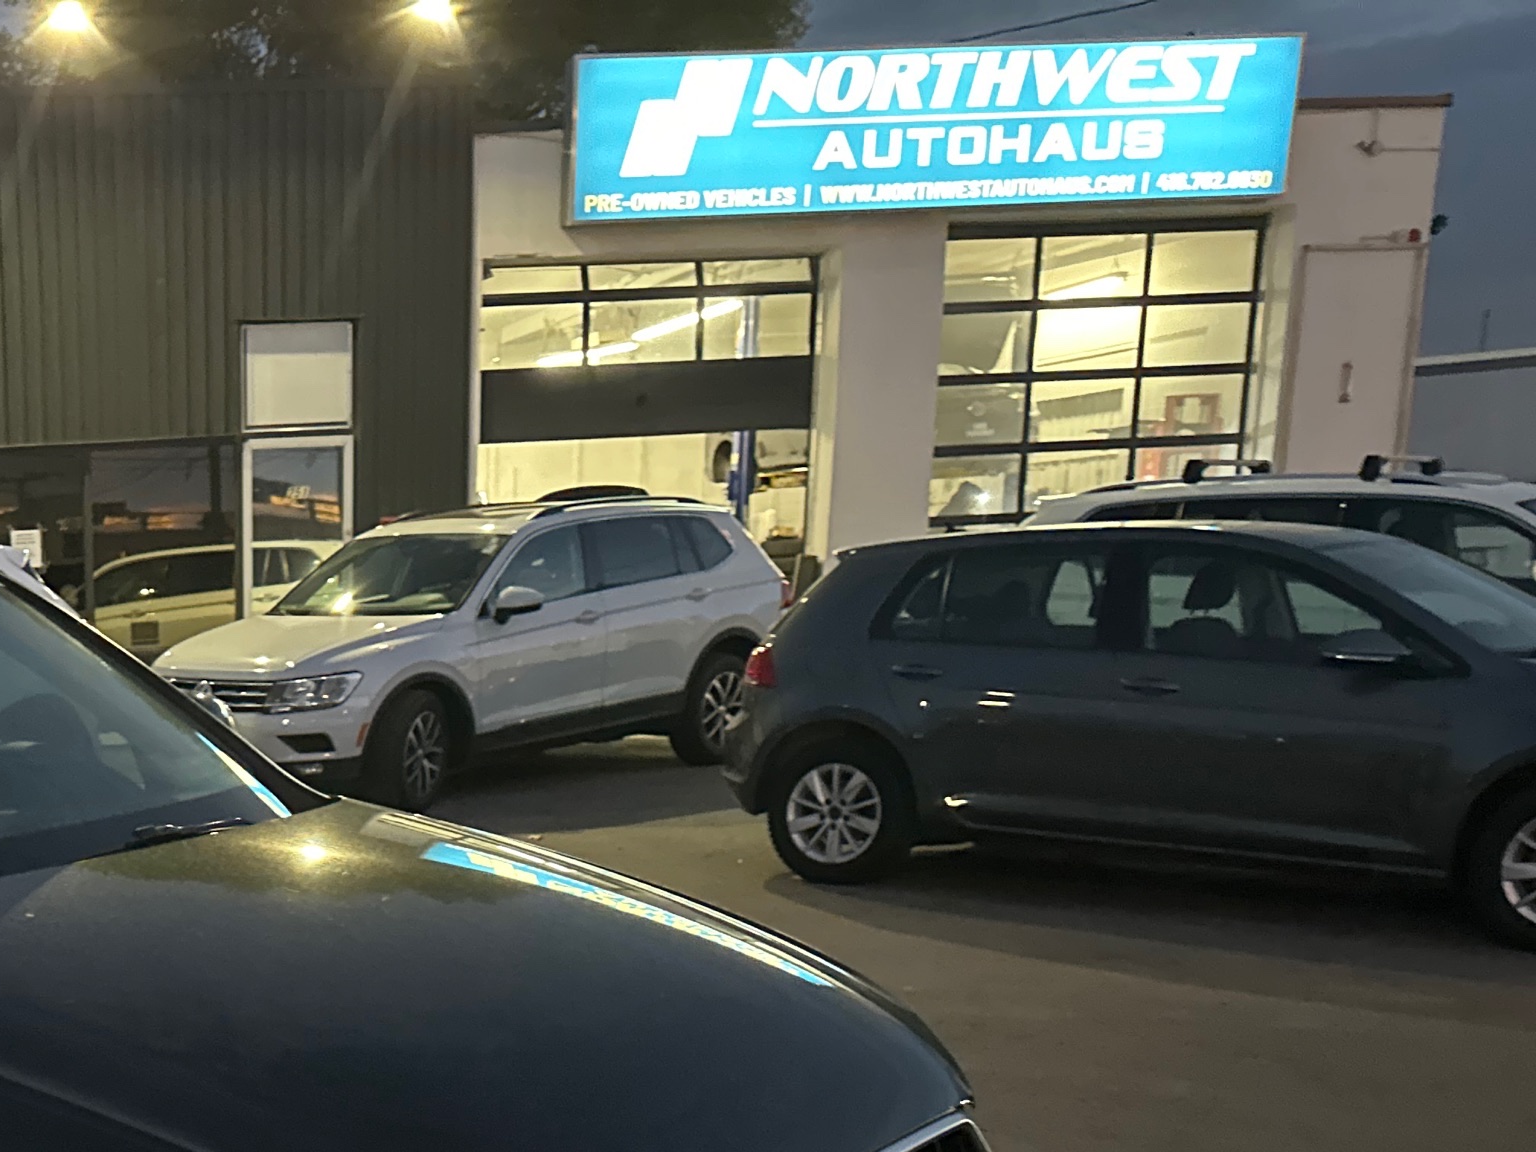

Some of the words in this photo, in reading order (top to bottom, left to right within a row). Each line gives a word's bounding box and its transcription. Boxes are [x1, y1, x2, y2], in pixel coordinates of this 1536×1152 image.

[752, 43, 1256, 116] NORTHWEST
[812, 120, 1166, 171] AUTOHAUS
[583, 190, 700, 213] PRE-OWNED
[703, 187, 797, 209] VEHICLES
